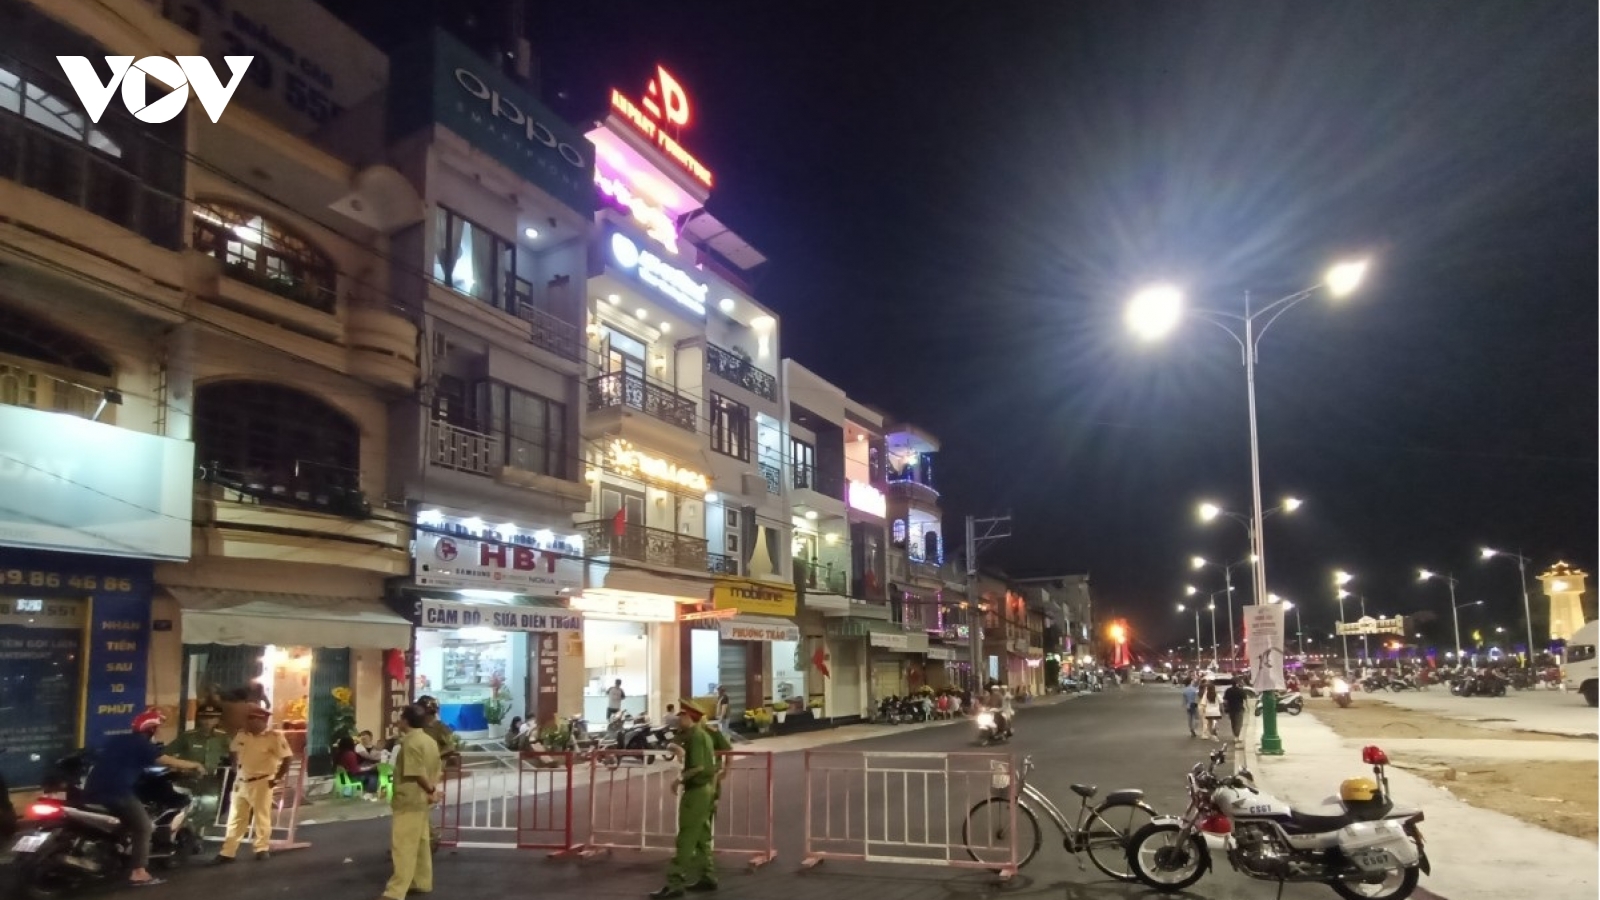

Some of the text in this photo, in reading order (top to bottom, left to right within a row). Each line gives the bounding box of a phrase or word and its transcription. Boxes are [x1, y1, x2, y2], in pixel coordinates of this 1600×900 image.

[480, 543, 561, 573] HBT
[455, 567, 491, 579] SAMSUNG
[528, 576, 555, 585] NOKIA
[730, 585, 783, 603] mobifone
[105, 662, 133, 672] SAU
[98, 703, 135, 715] PHÚT
